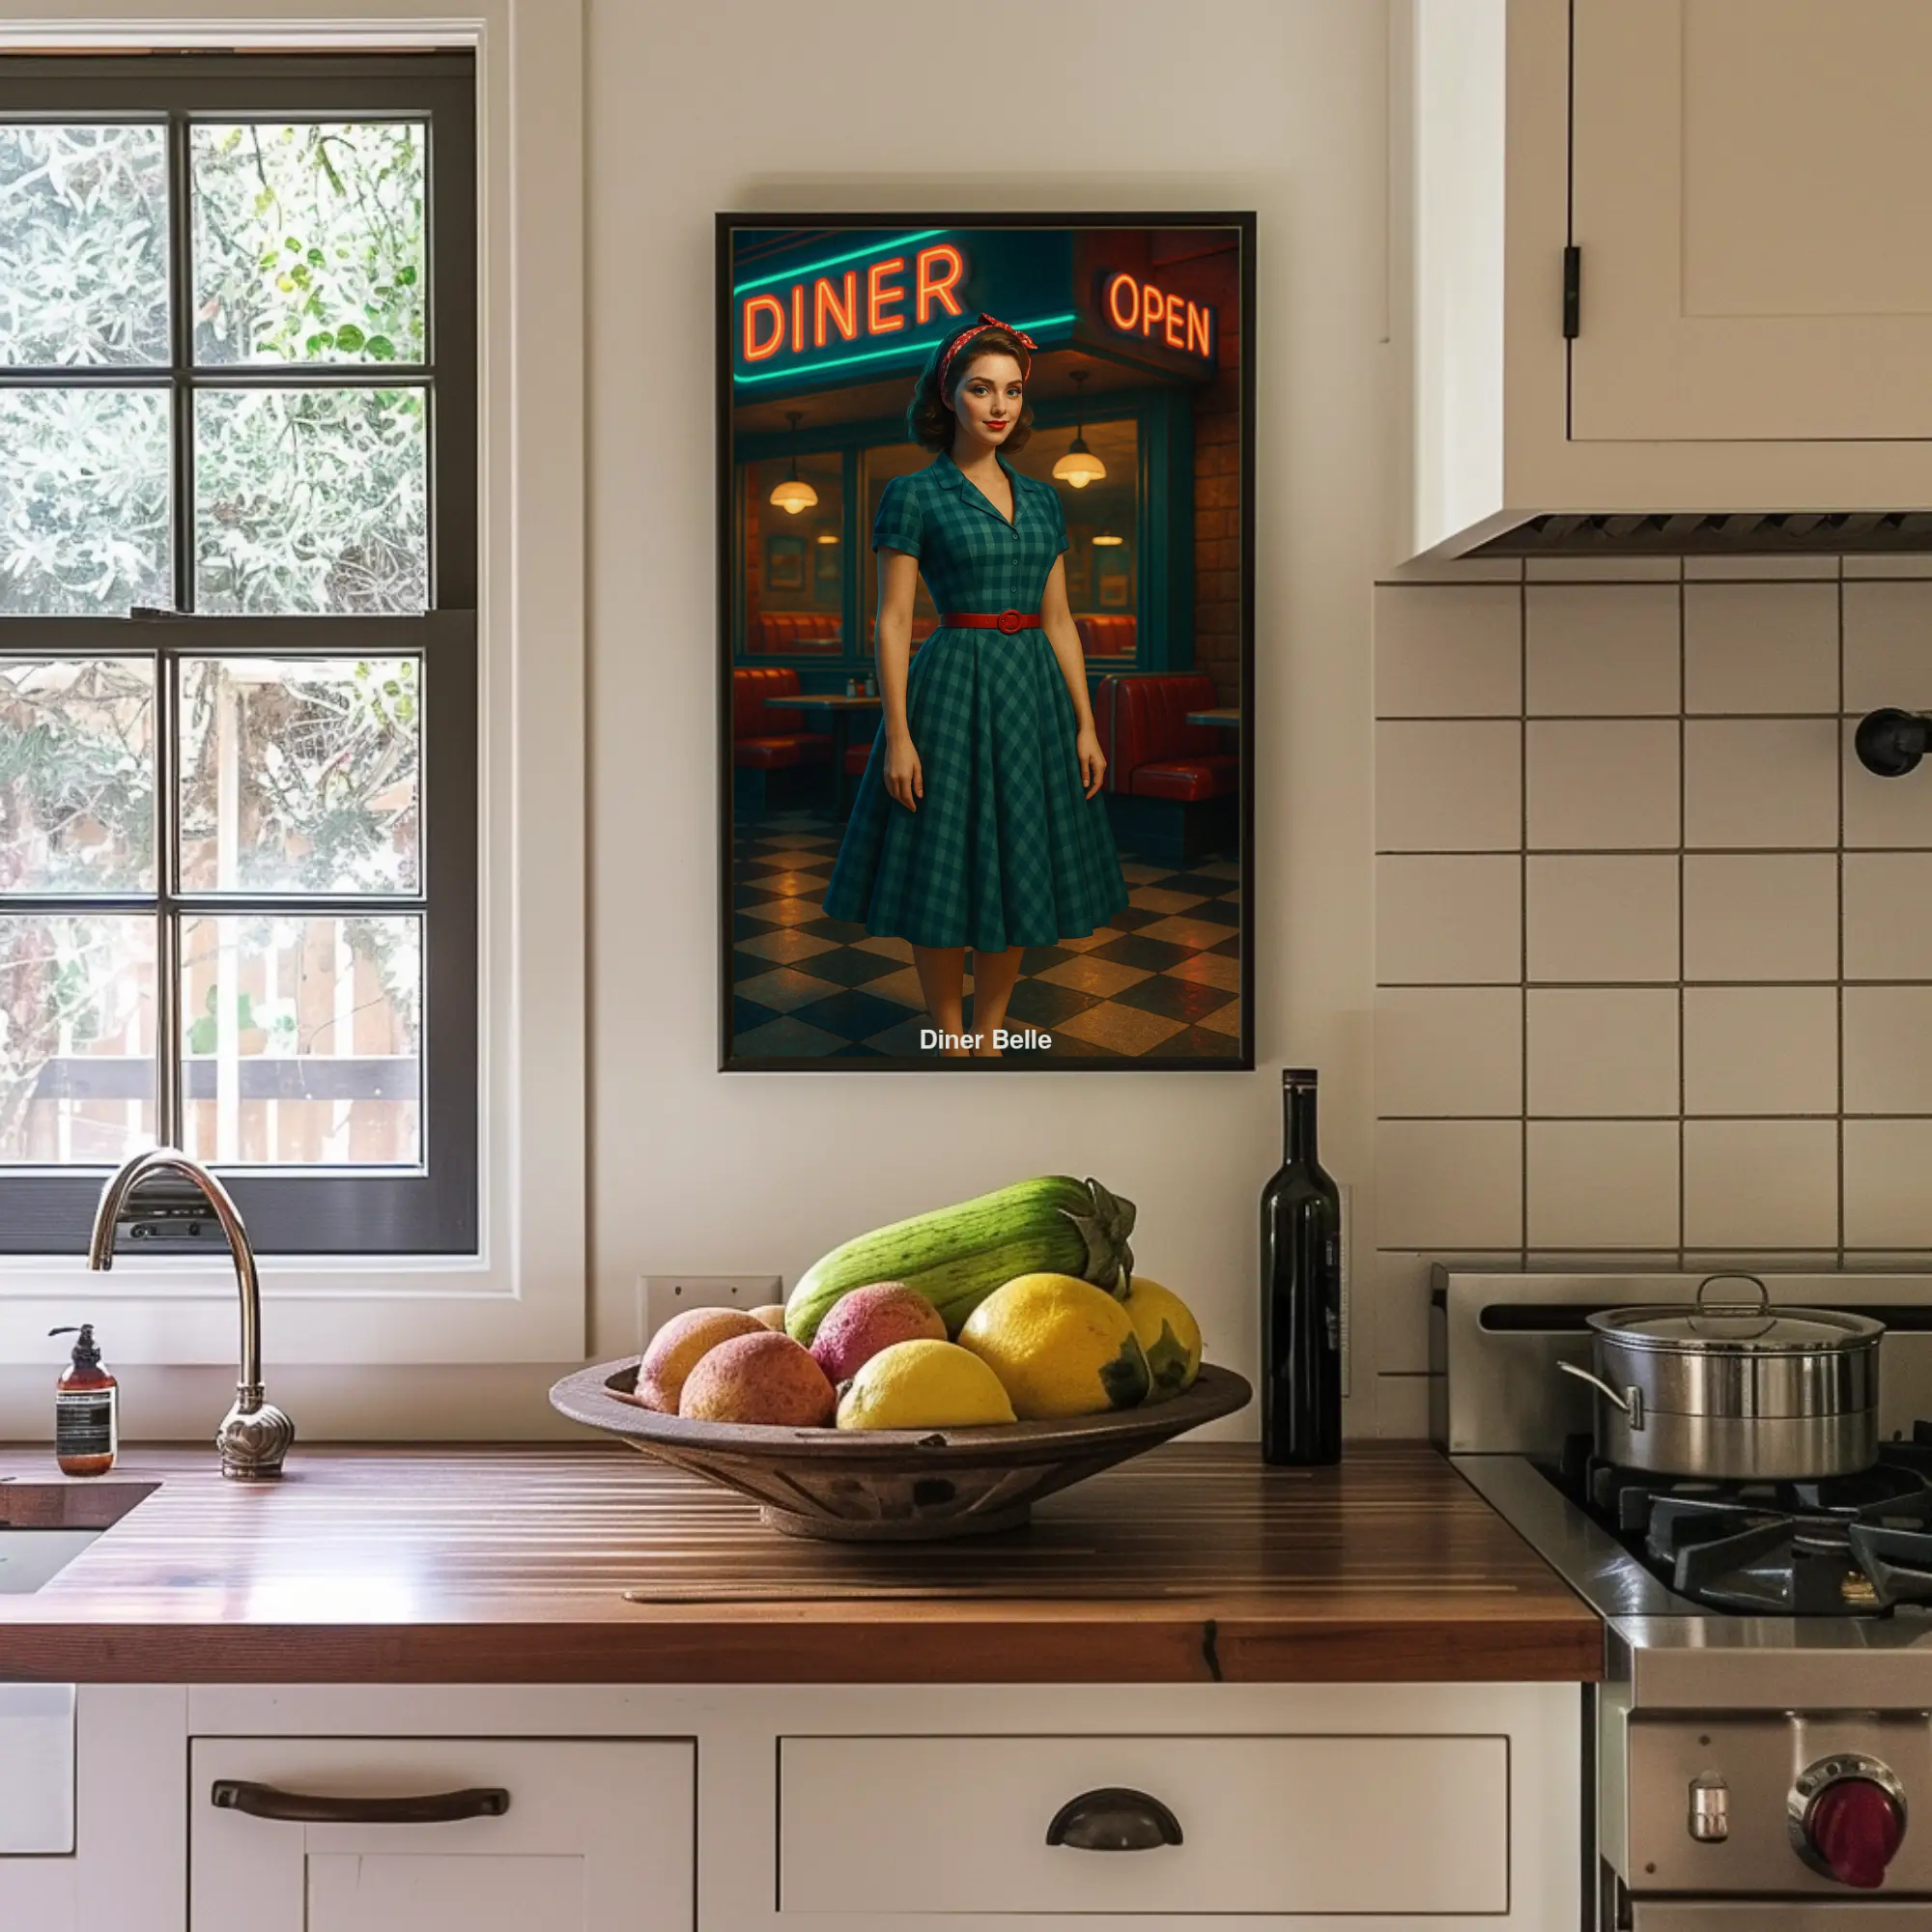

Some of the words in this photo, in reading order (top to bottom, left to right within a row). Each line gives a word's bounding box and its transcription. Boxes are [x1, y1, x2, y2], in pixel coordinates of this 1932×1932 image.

[743, 243, 963, 362] DINER
[1109, 273, 1210, 358] OPEN
[920, 1029, 984, 1050] Diner
[992, 1029, 1053, 1050] Belle
